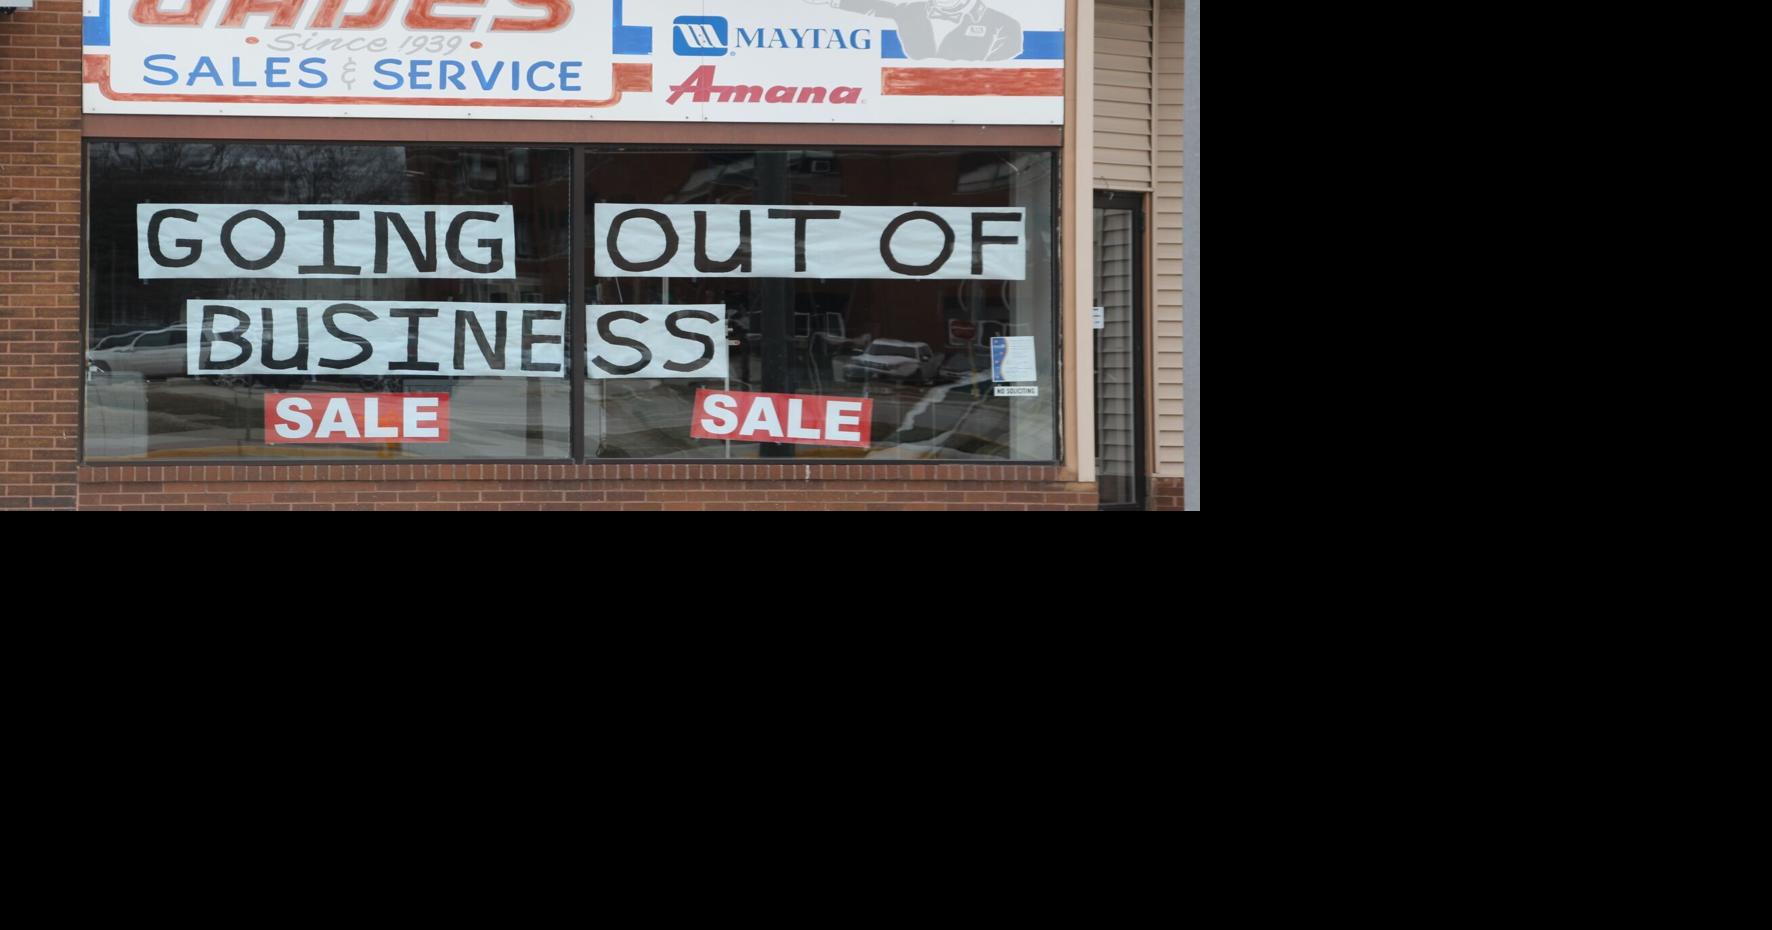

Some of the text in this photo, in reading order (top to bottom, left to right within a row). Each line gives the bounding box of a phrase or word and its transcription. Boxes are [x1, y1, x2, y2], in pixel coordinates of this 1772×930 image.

[266, 32, 463, 56] Since 1939
[735, 27, 872, 50] MAYTAG
[143, 53, 329, 89] SALES
[372, 58, 583, 92] SERVICE
[666, 65, 863, 105] Amana
[147, 208, 1023, 275] GOING OUT OF
[274, 397, 440, 439] SALE
[700, 393, 862, 442] SALE
